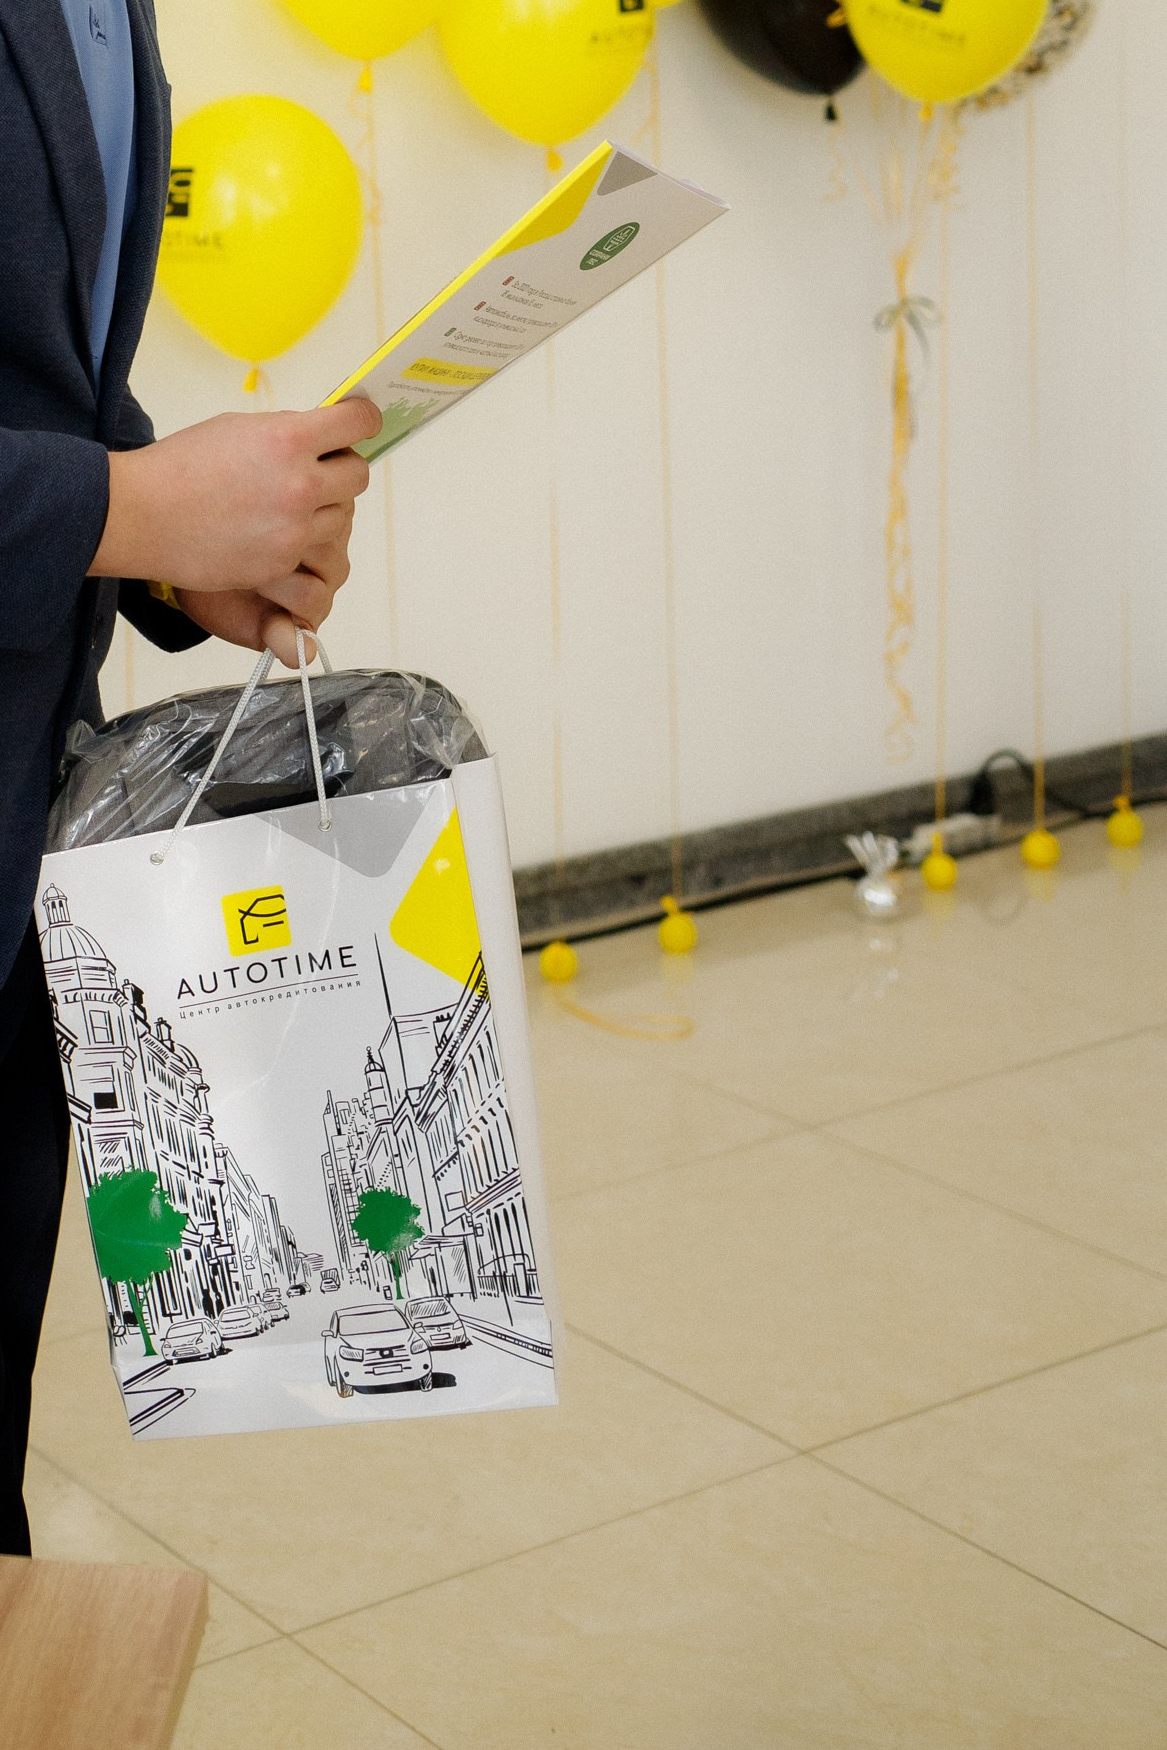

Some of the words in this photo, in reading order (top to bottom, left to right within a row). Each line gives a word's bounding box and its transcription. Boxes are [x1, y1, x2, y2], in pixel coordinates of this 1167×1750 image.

[177, 945, 357, 1000] AUTOTIME
[179, 1005, 220, 1019] Центр
[227, 979, 361, 1010] автокредитования
